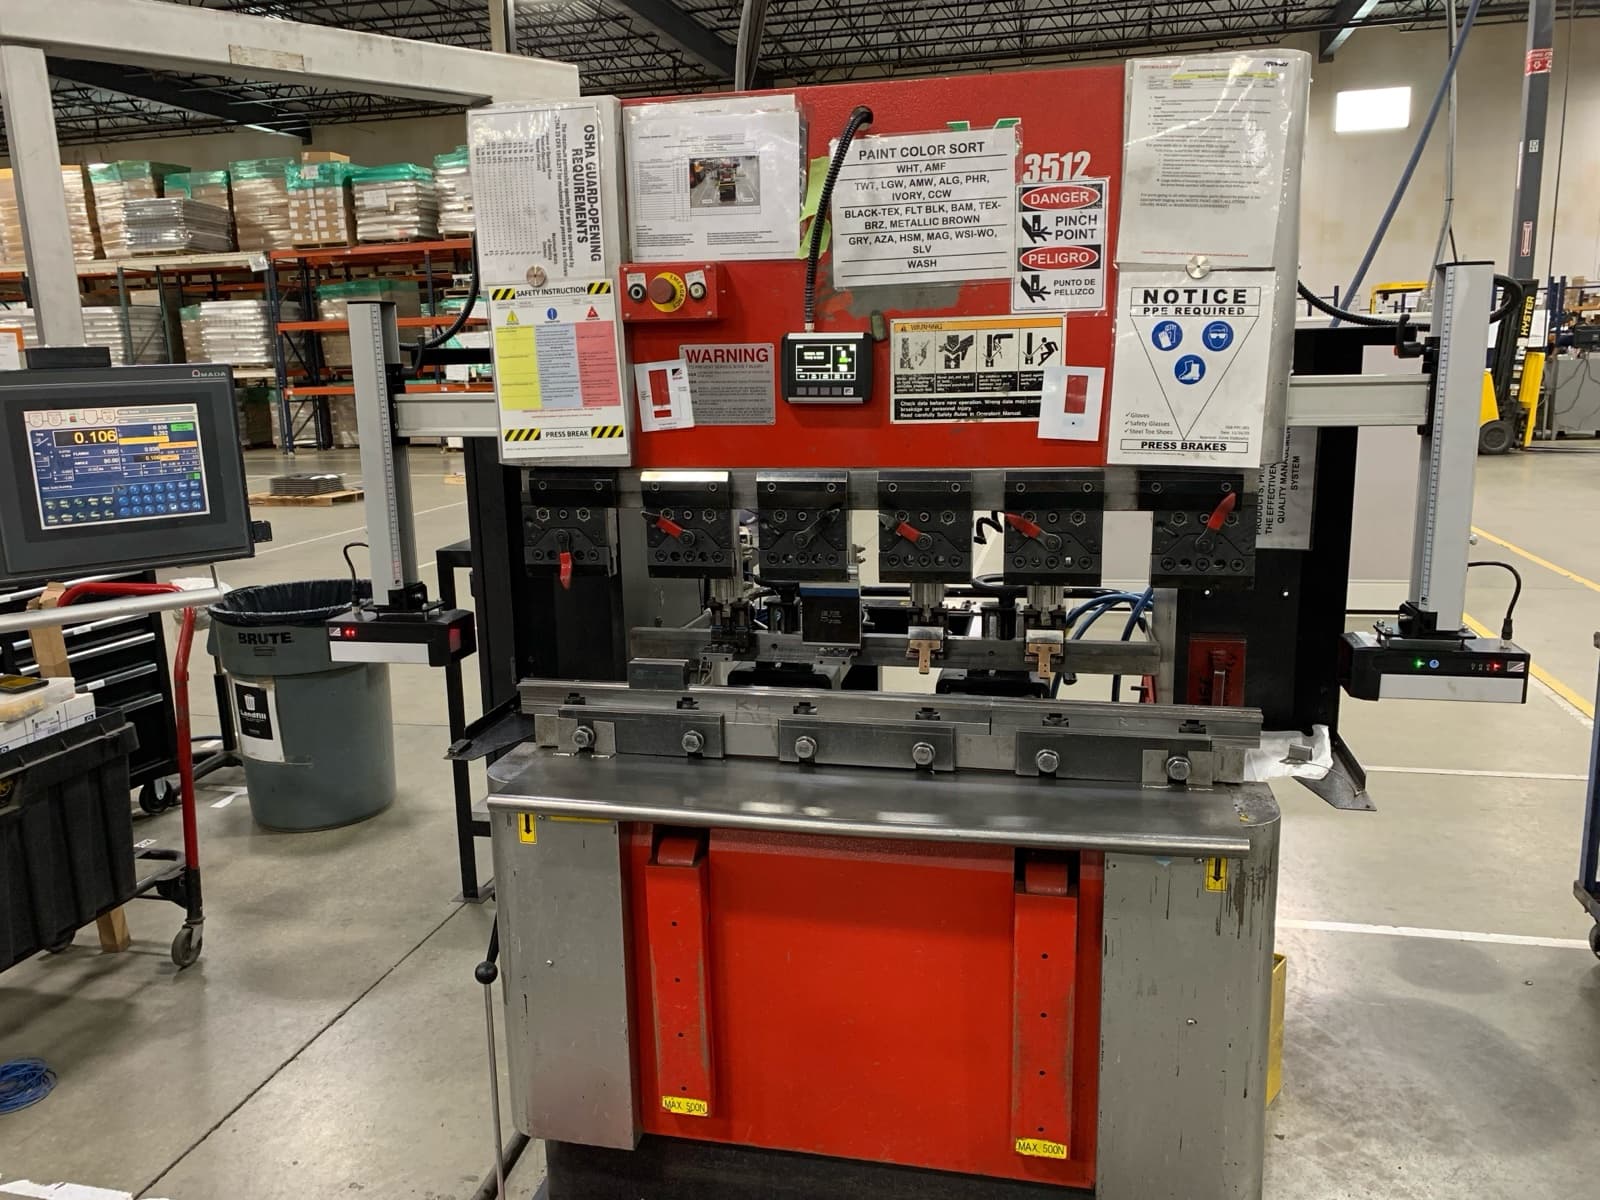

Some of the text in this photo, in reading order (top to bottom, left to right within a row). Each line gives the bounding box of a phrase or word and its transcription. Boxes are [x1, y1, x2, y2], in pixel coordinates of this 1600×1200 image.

[859, 142, 984, 160] PAINT COLOR SORT
[896, 162, 946, 174] WHT, AMF
[1023, 151, 1091, 184] 3512
[855, 175, 989, 191] TWT, LGW, AMW, ALG, PHR,
[572, 148, 588, 243] REQUIREMENTS
[584, 125, 601, 261] OSHA GUARD-OPENING
[892, 189, 951, 201] IVORY, CCW
[1030, 191, 1089, 205] DANGER
[845, 201, 1001, 219] BLACK-TEX, FLT BLK, BAM, TEX-
[865, 215, 980, 230] BRZ, METALLIC BROWN
[1055, 215, 1097, 226] PINCH
[849, 229, 997, 246] GRY, AZA, HSM, MAG, WSI-WO,
[1055, 229, 1096, 240] POINT
[913, 245, 931, 254] SLV
[908, 259, 937, 269] WASH
[1028, 252, 1089, 264] PELIGRO
[516, 287, 586, 298] SAFETY INSTRUCTION
[1054, 288, 1095, 296] PELLIZCO
[1143, 289, 1247, 304] NOTICE
[1143, 307, 1245, 315] PPE REQUIRED
[1521, 296, 1535, 336] HYSTER
[686, 348, 769, 363] WARNING
[73, 430, 117, 444] 0.106
[1141, 441, 1227, 451] PRESS BRAKES
[1290, 456, 1300, 490] SYSTEM
[1277, 487, 1286, 524] QUALITY
[1265, 518, 1273, 534] THE
[238, 632, 292, 645] BRUTE
[240, 710, 267, 720] Landfill
[687, 1102, 705, 1112] 500N
[1043, 1144, 1064, 1154] 500N
